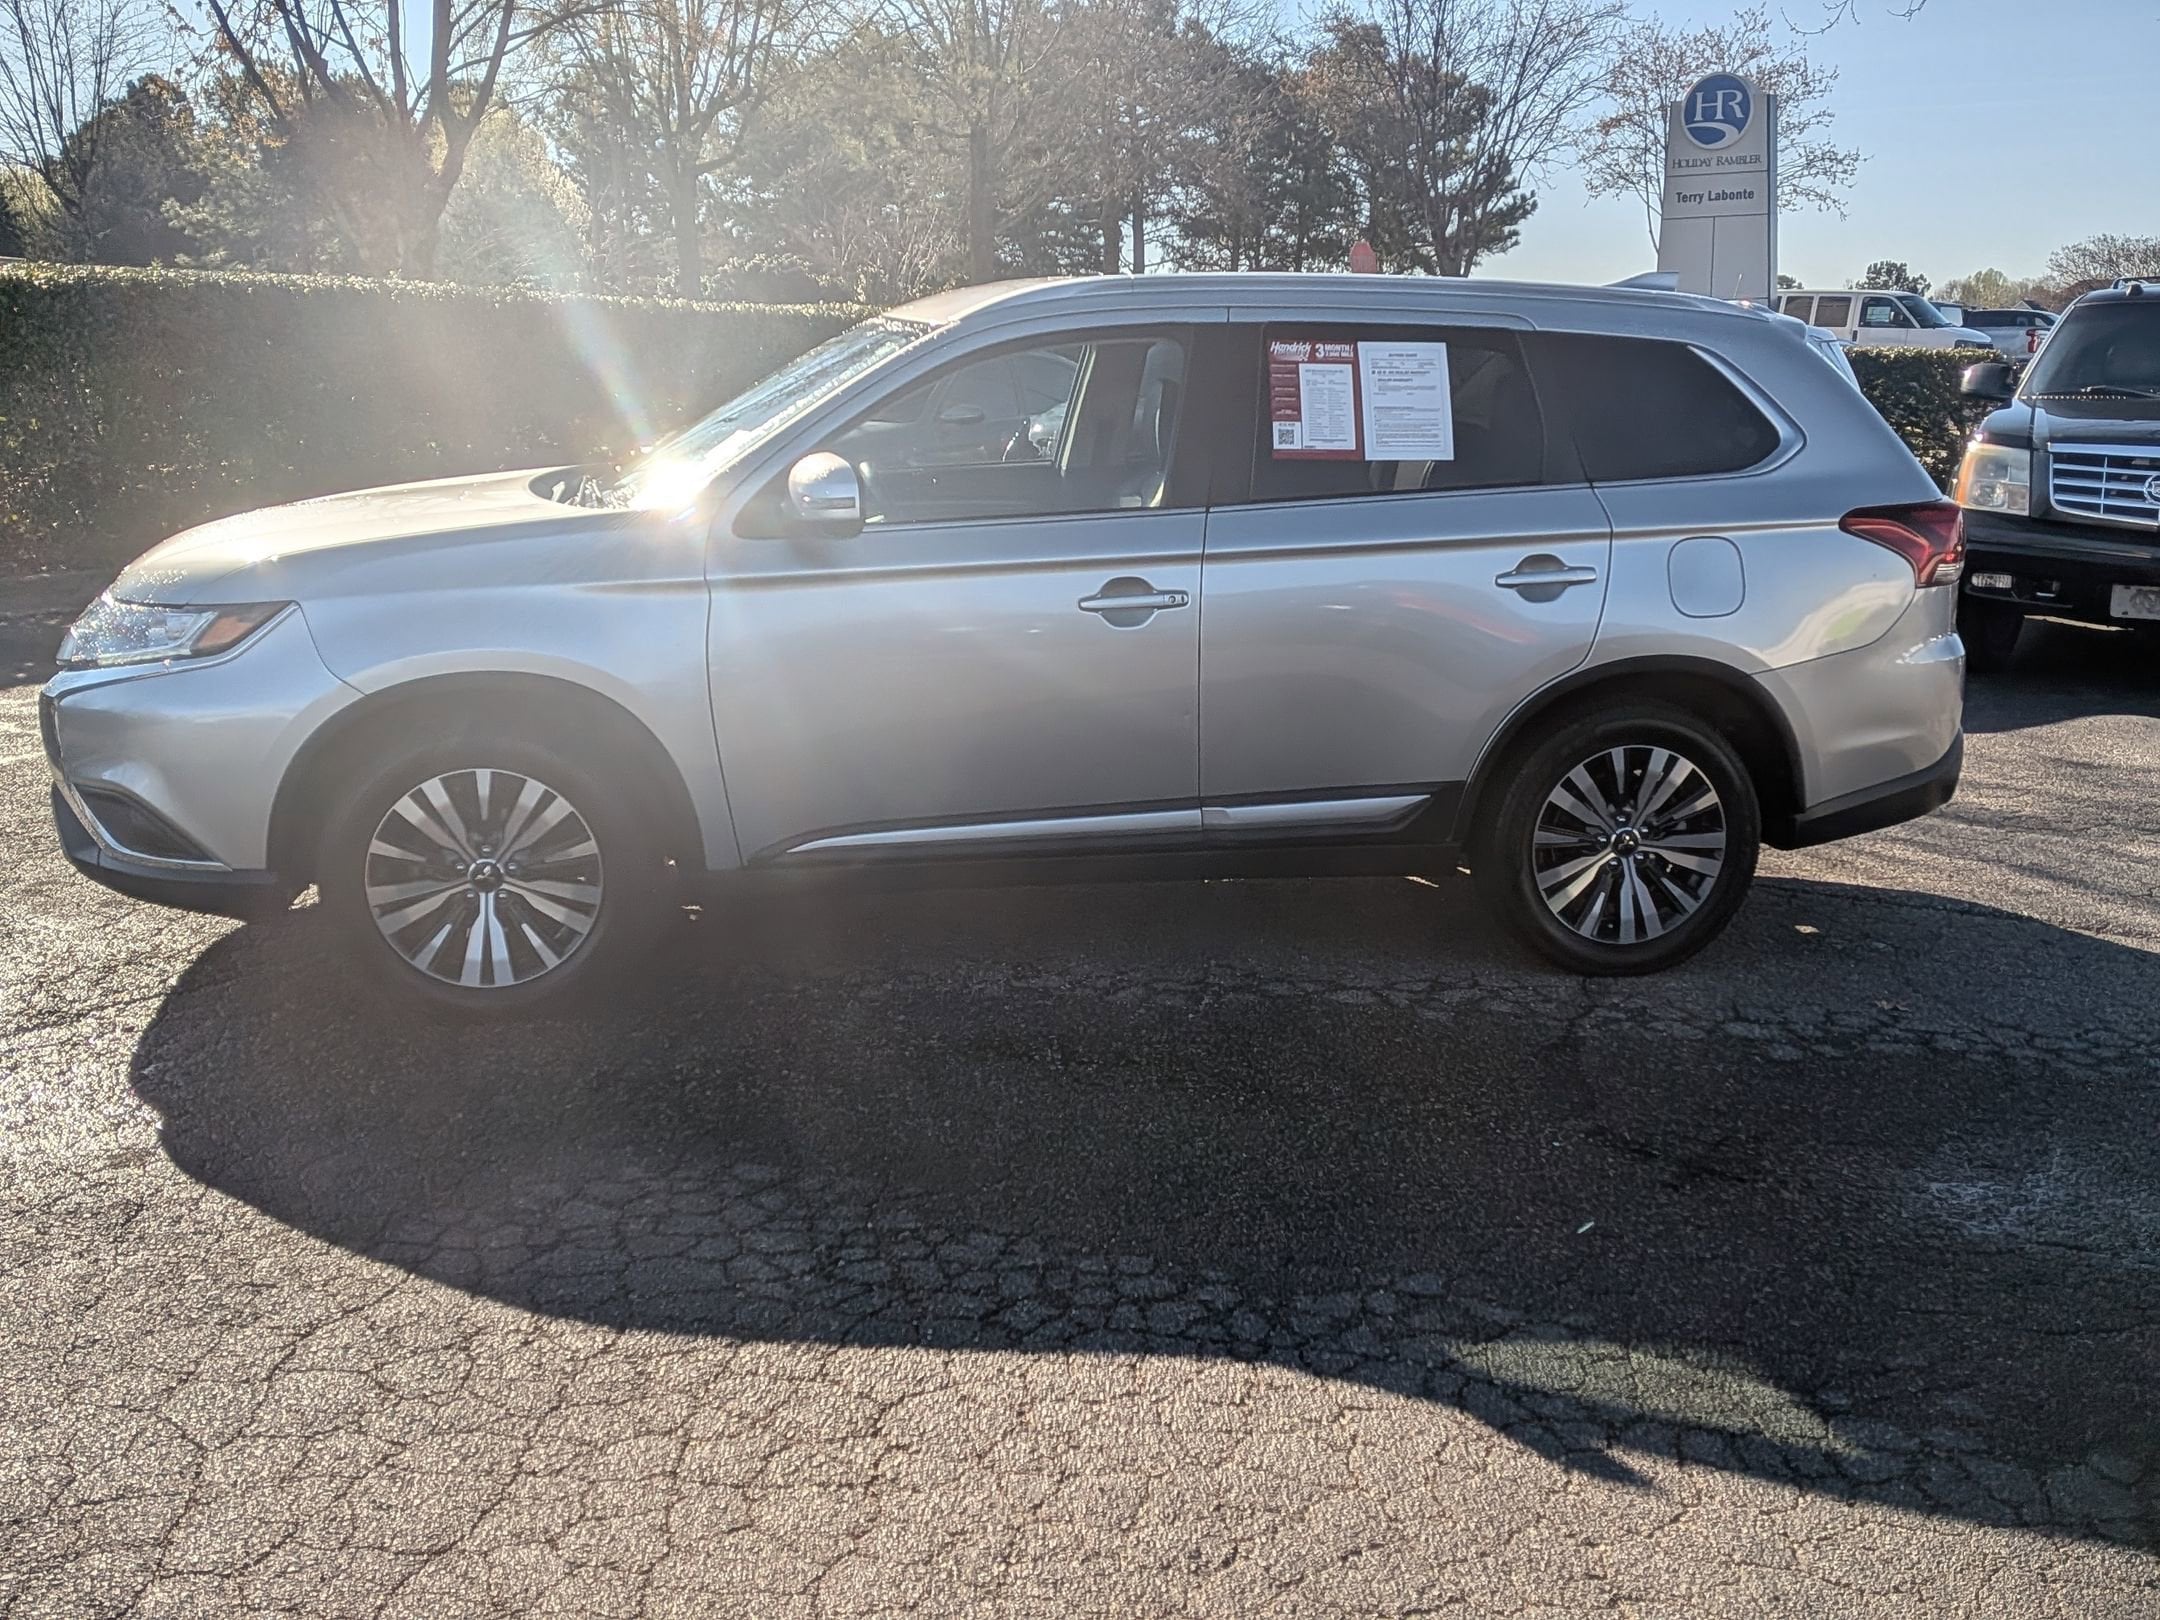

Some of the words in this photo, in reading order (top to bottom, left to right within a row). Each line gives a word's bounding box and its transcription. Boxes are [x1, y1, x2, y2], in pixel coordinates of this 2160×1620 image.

[1694, 89, 1744, 121] HR
[1672, 157, 1712, 169] HOLIDAY
[1716, 154, 1762, 166] RAMBLER
[1676, 192, 1704, 204] Terry
[1708, 188, 1754, 201] Labonte
[1315, 343, 1325, 358] 3
